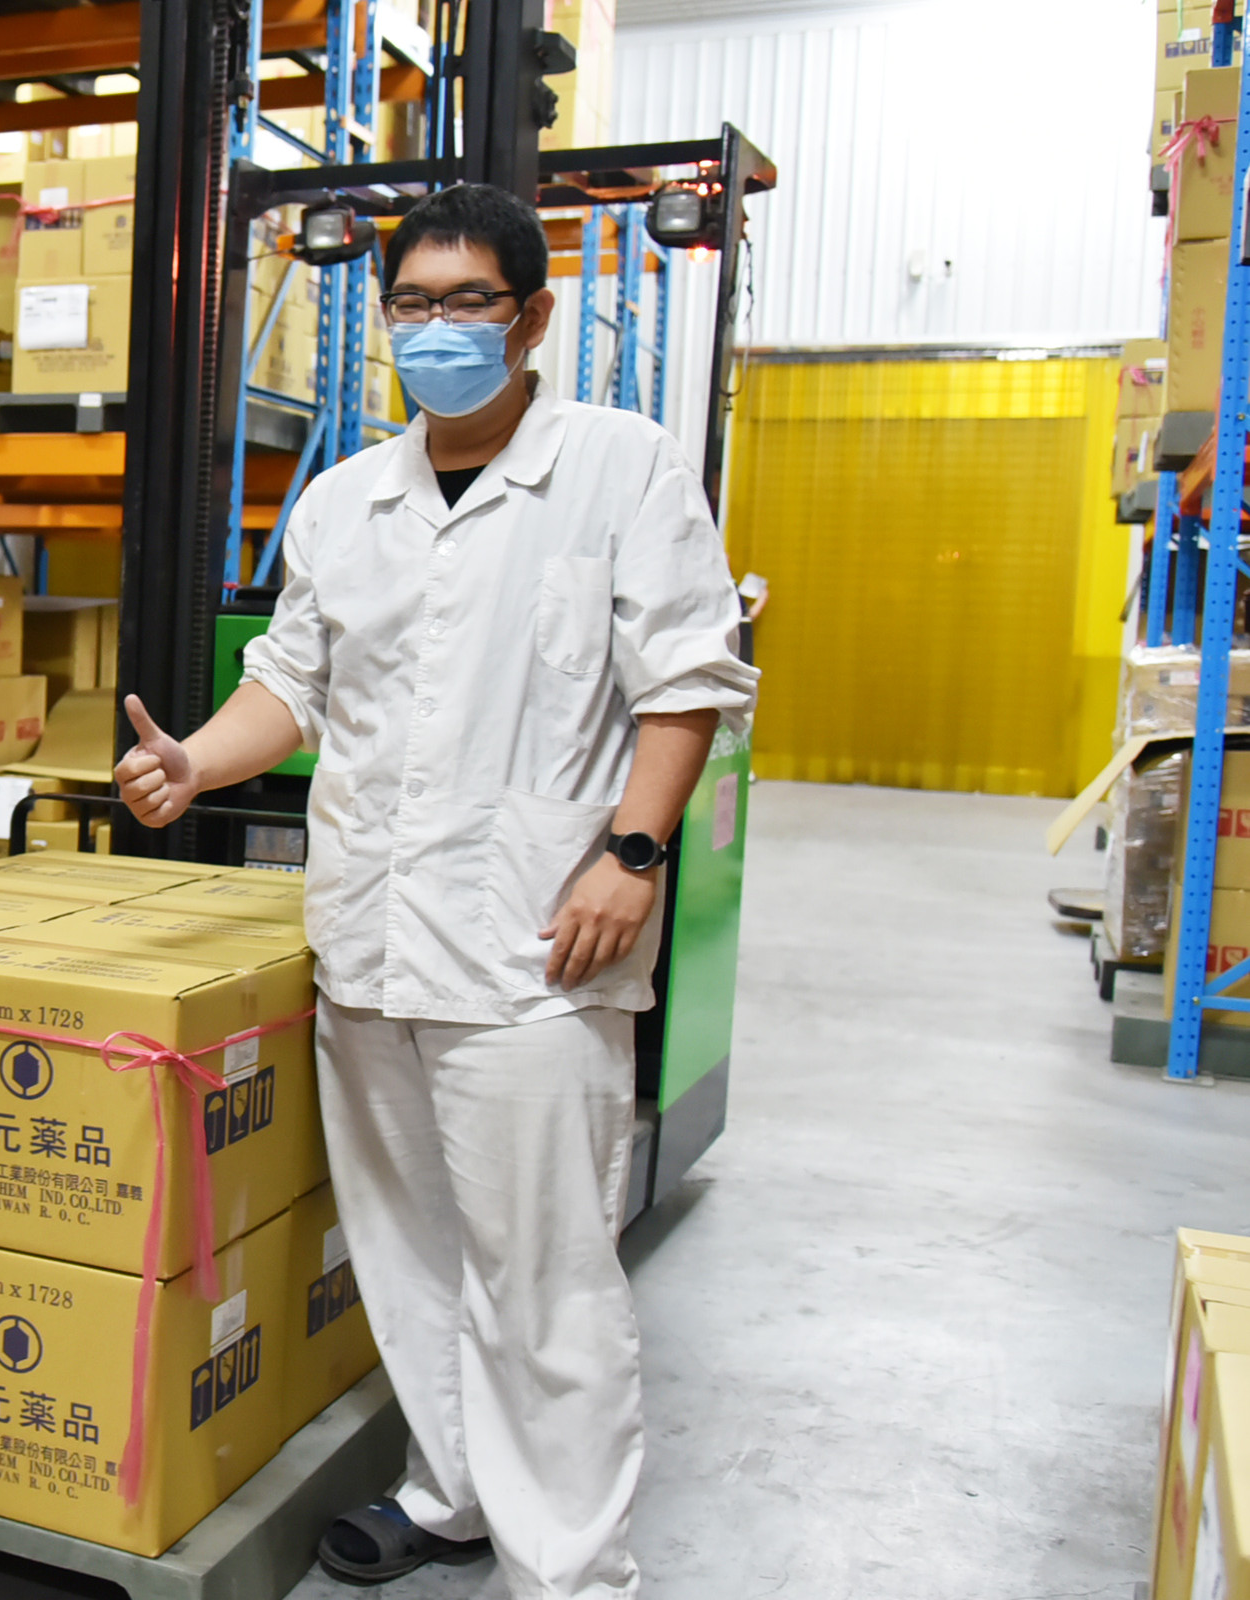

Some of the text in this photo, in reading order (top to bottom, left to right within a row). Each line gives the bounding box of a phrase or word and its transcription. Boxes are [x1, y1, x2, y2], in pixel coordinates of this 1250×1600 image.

[18, 1009, 31, 1023] x
[38, 1006, 85, 1030] 1728
[39, 1187, 67, 1206] IND.
[9, 1283, 22, 1298] x
[27, 1282, 74, 1310] 1728
[29, 1460, 56, 1480] IND.
